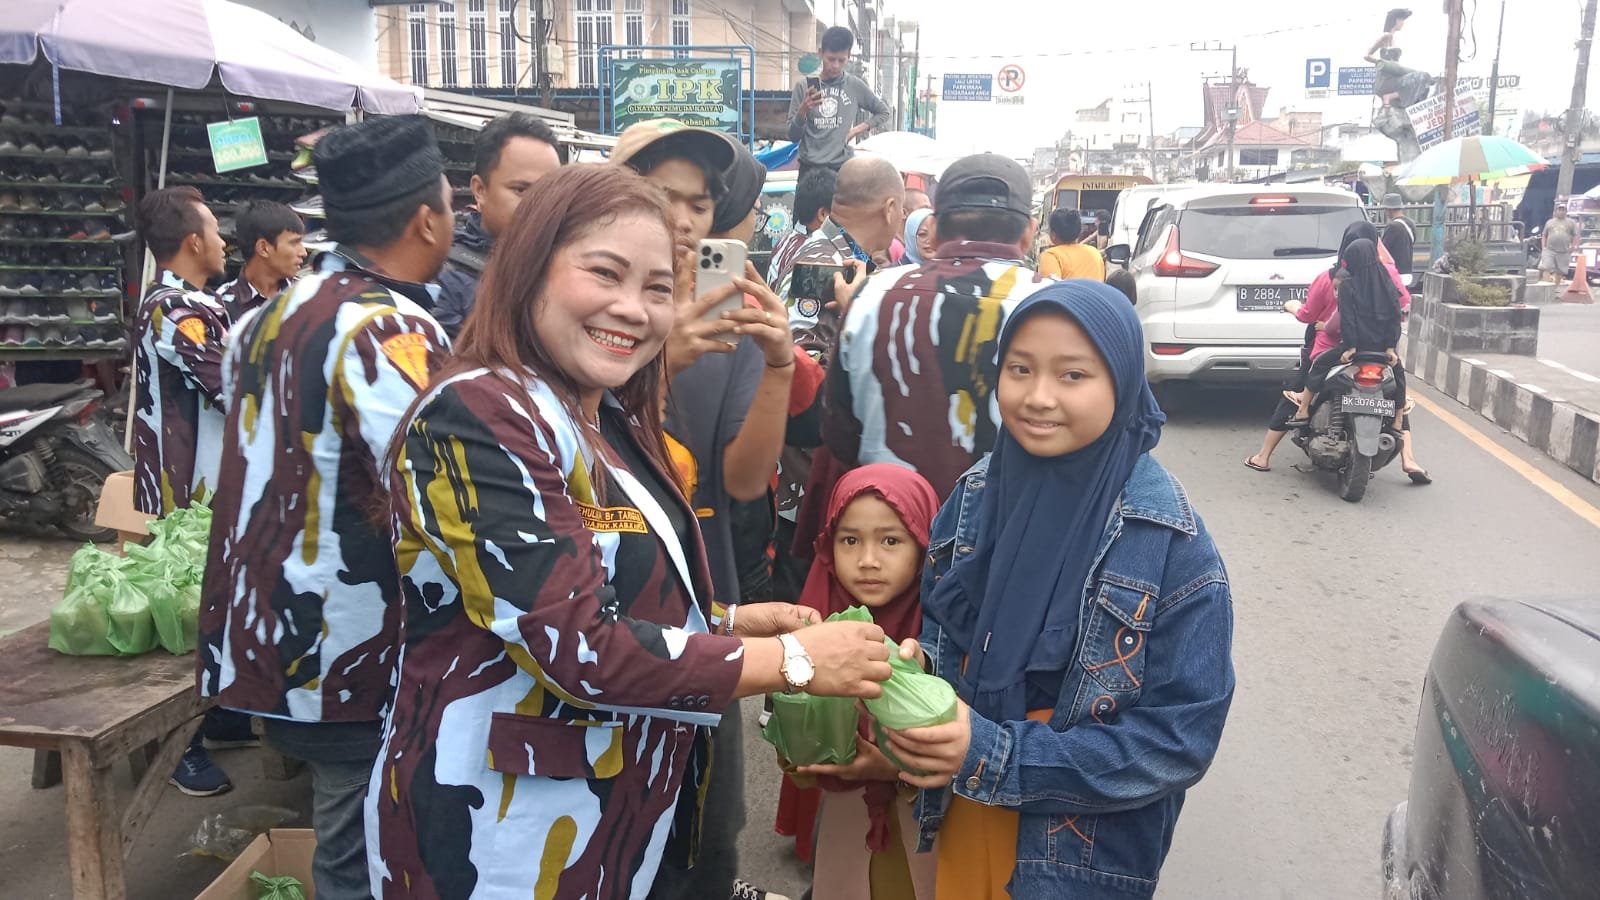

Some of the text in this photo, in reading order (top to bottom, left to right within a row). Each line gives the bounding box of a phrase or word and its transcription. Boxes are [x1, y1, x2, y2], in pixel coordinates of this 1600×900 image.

[1309, 61, 1326, 84] P
[656, 78, 723, 101] IPK
[1240, 287, 1248, 300] B
[1253, 287, 1281, 300] 2884
[1343, 396, 1394, 409] BK 3076 AGM
[605, 511, 614, 520] Br
